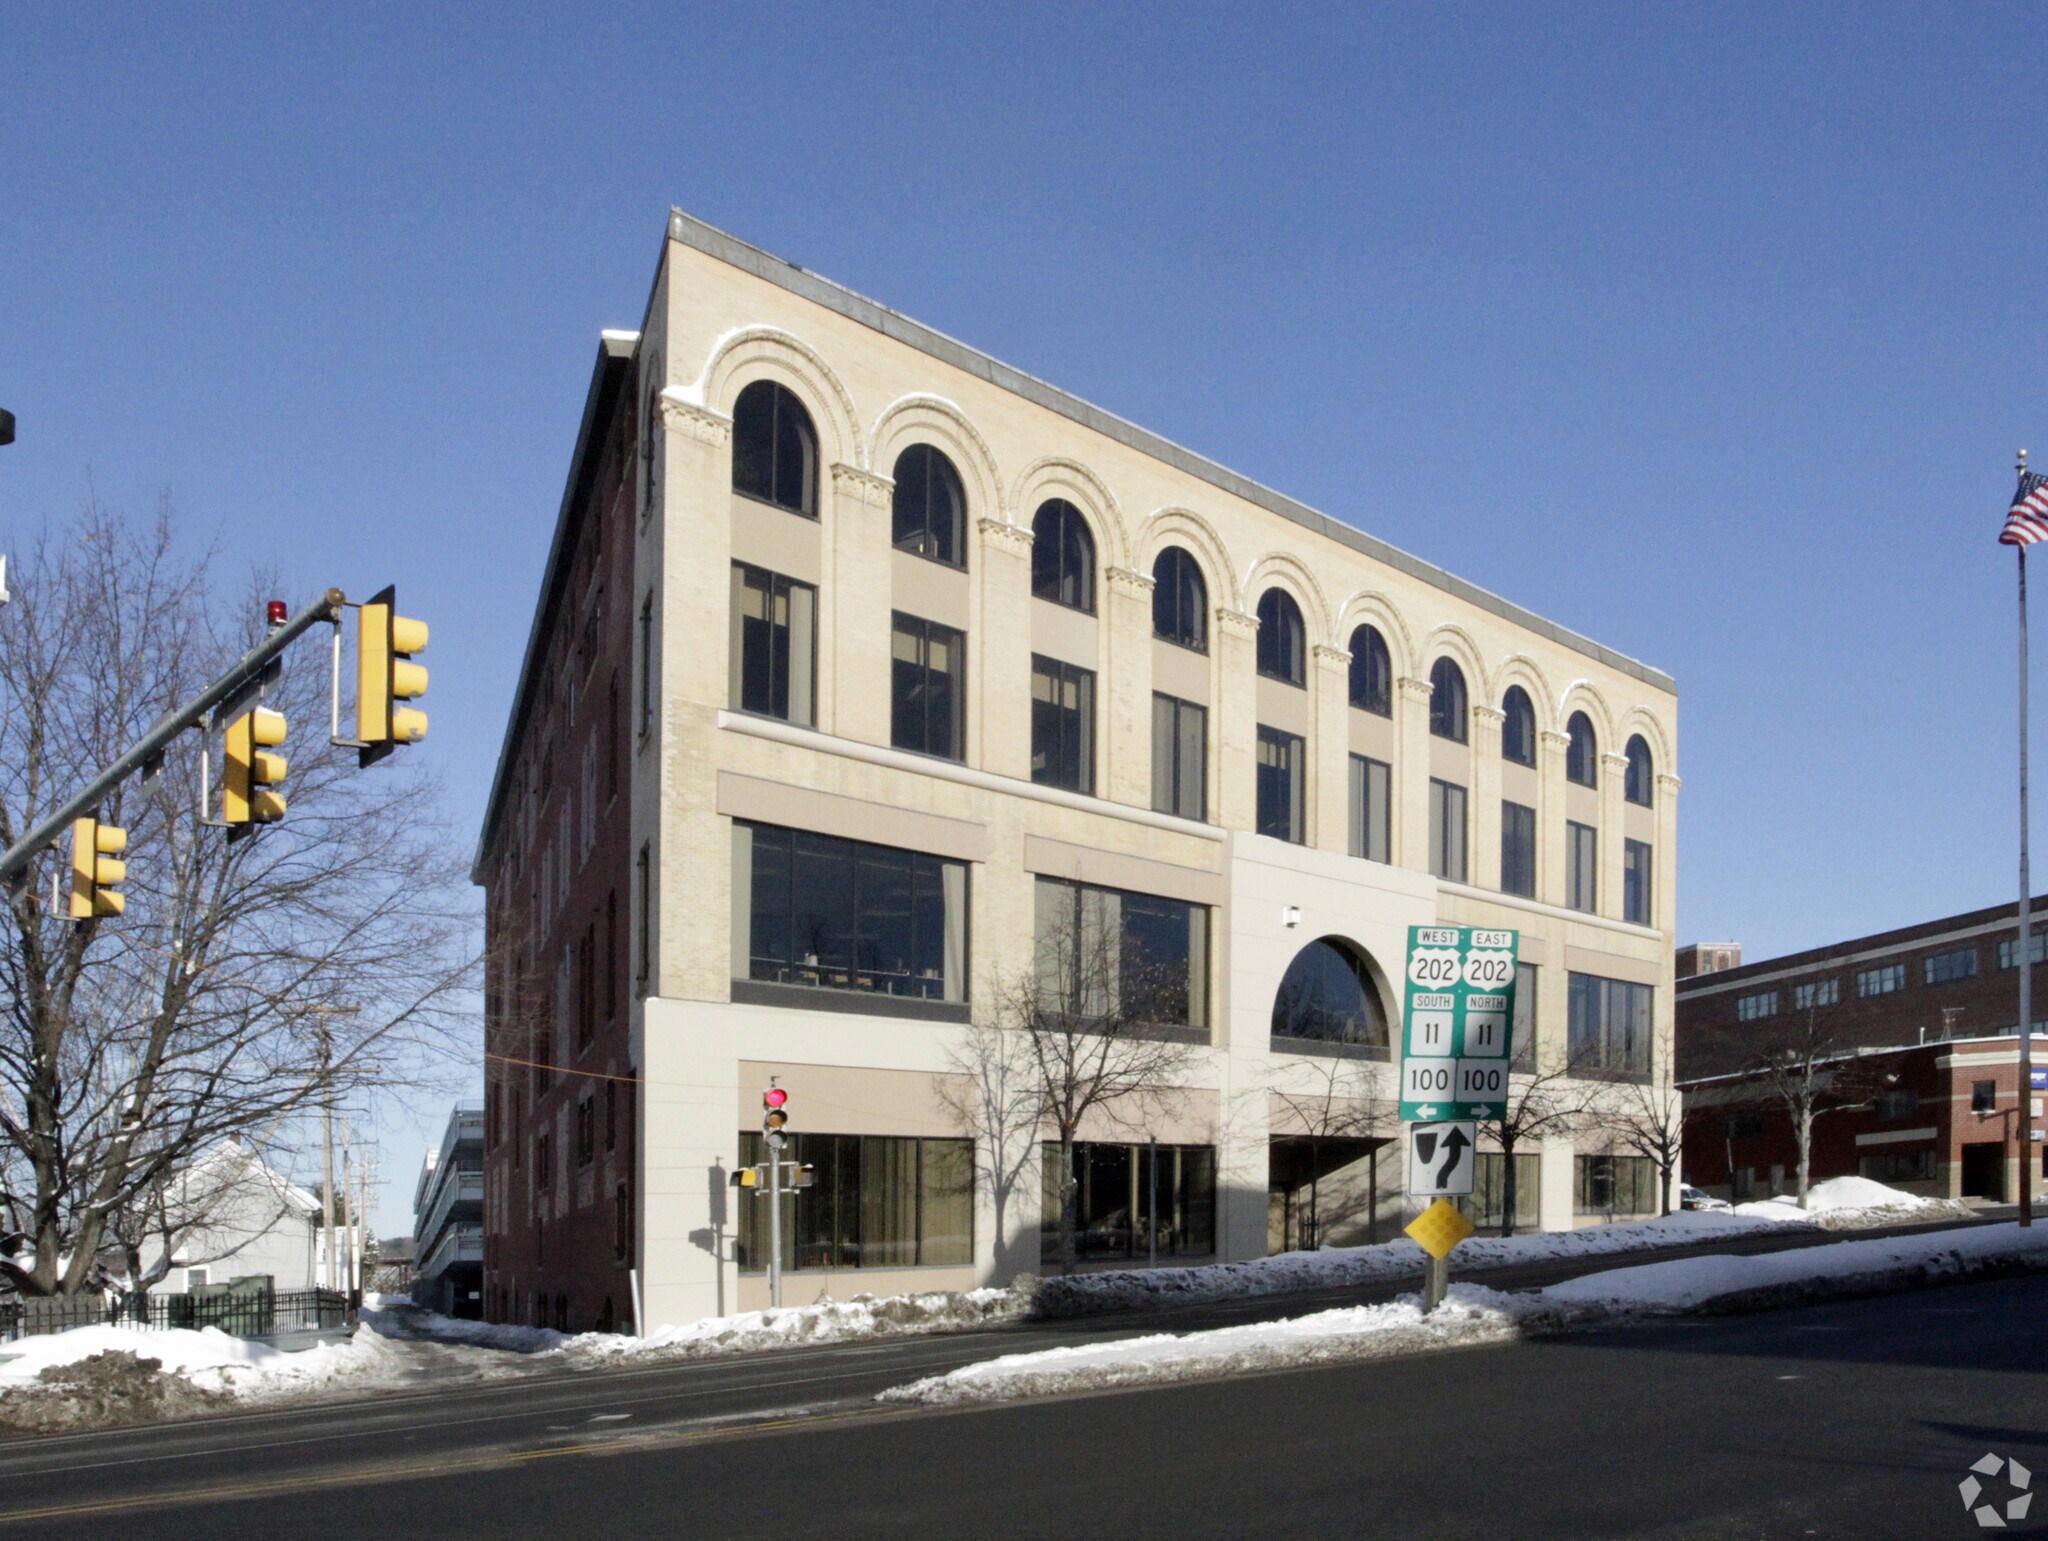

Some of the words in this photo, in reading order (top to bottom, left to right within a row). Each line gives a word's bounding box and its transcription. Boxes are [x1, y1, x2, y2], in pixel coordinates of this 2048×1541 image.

[1422, 931, 1455, 943] WEST
[1476, 933, 1507, 945] EAST
[1416, 958, 1454, 981] 202
[1470, 959, 1507, 982] 202
[1417, 995, 1450, 1007] SOUTH
[1470, 996, 1504, 1008] NORTH
[1425, 1023, 1439, 1044] 11
[1478, 1024, 1492, 1046] 11
[1411, 1069, 1448, 1091] 100
[1464, 1069, 1500, 1092] 100
